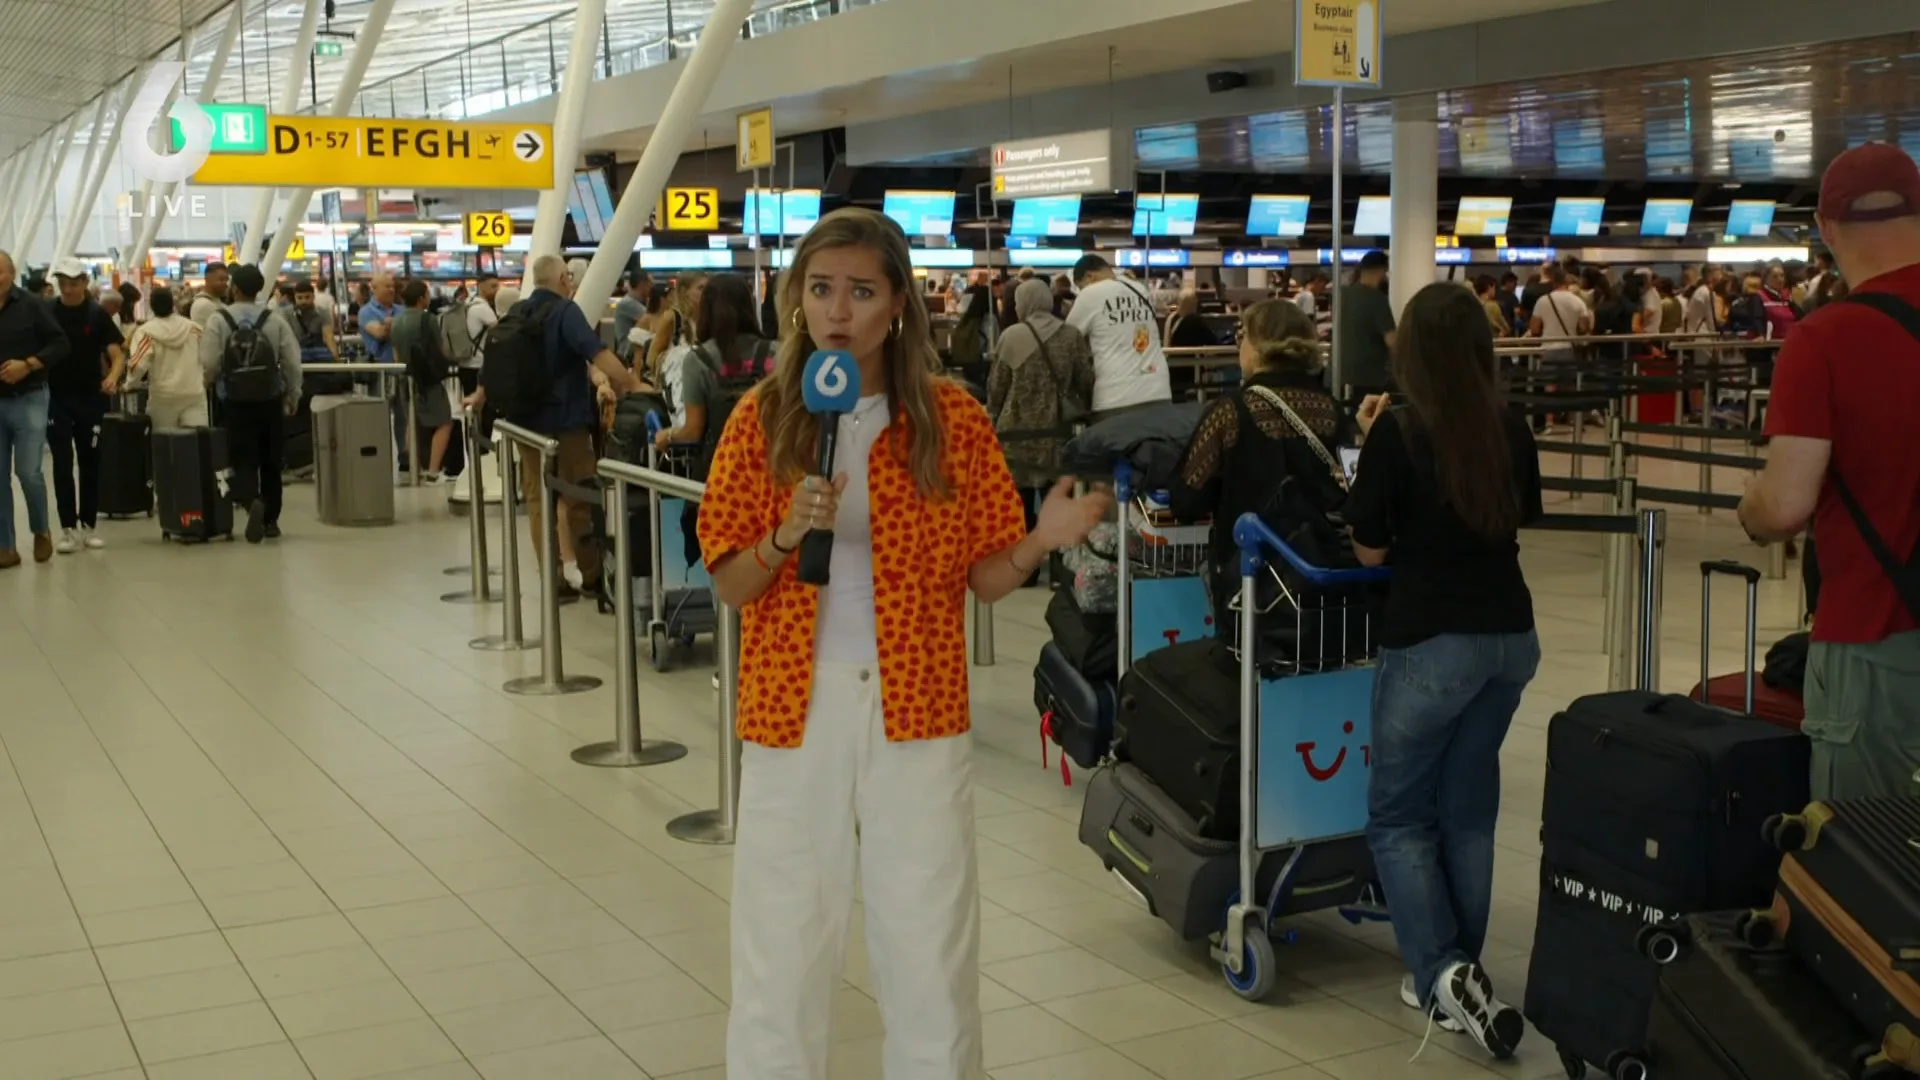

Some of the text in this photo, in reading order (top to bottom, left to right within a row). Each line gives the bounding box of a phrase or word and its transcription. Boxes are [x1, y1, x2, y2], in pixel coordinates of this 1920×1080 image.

[1315, 3, 1353, 19] Egyptair
[274, 125, 300, 155] D
[304, 131, 349, 149] 1-57
[1005, 143, 1060, 162] Passengers only
[674, 191, 711, 219] 25
[476, 215, 505, 237] 26
[815, 355, 848, 398] 6
[1563, 877, 1584, 898] VIP
[1601, 890, 1623, 912] VIP
